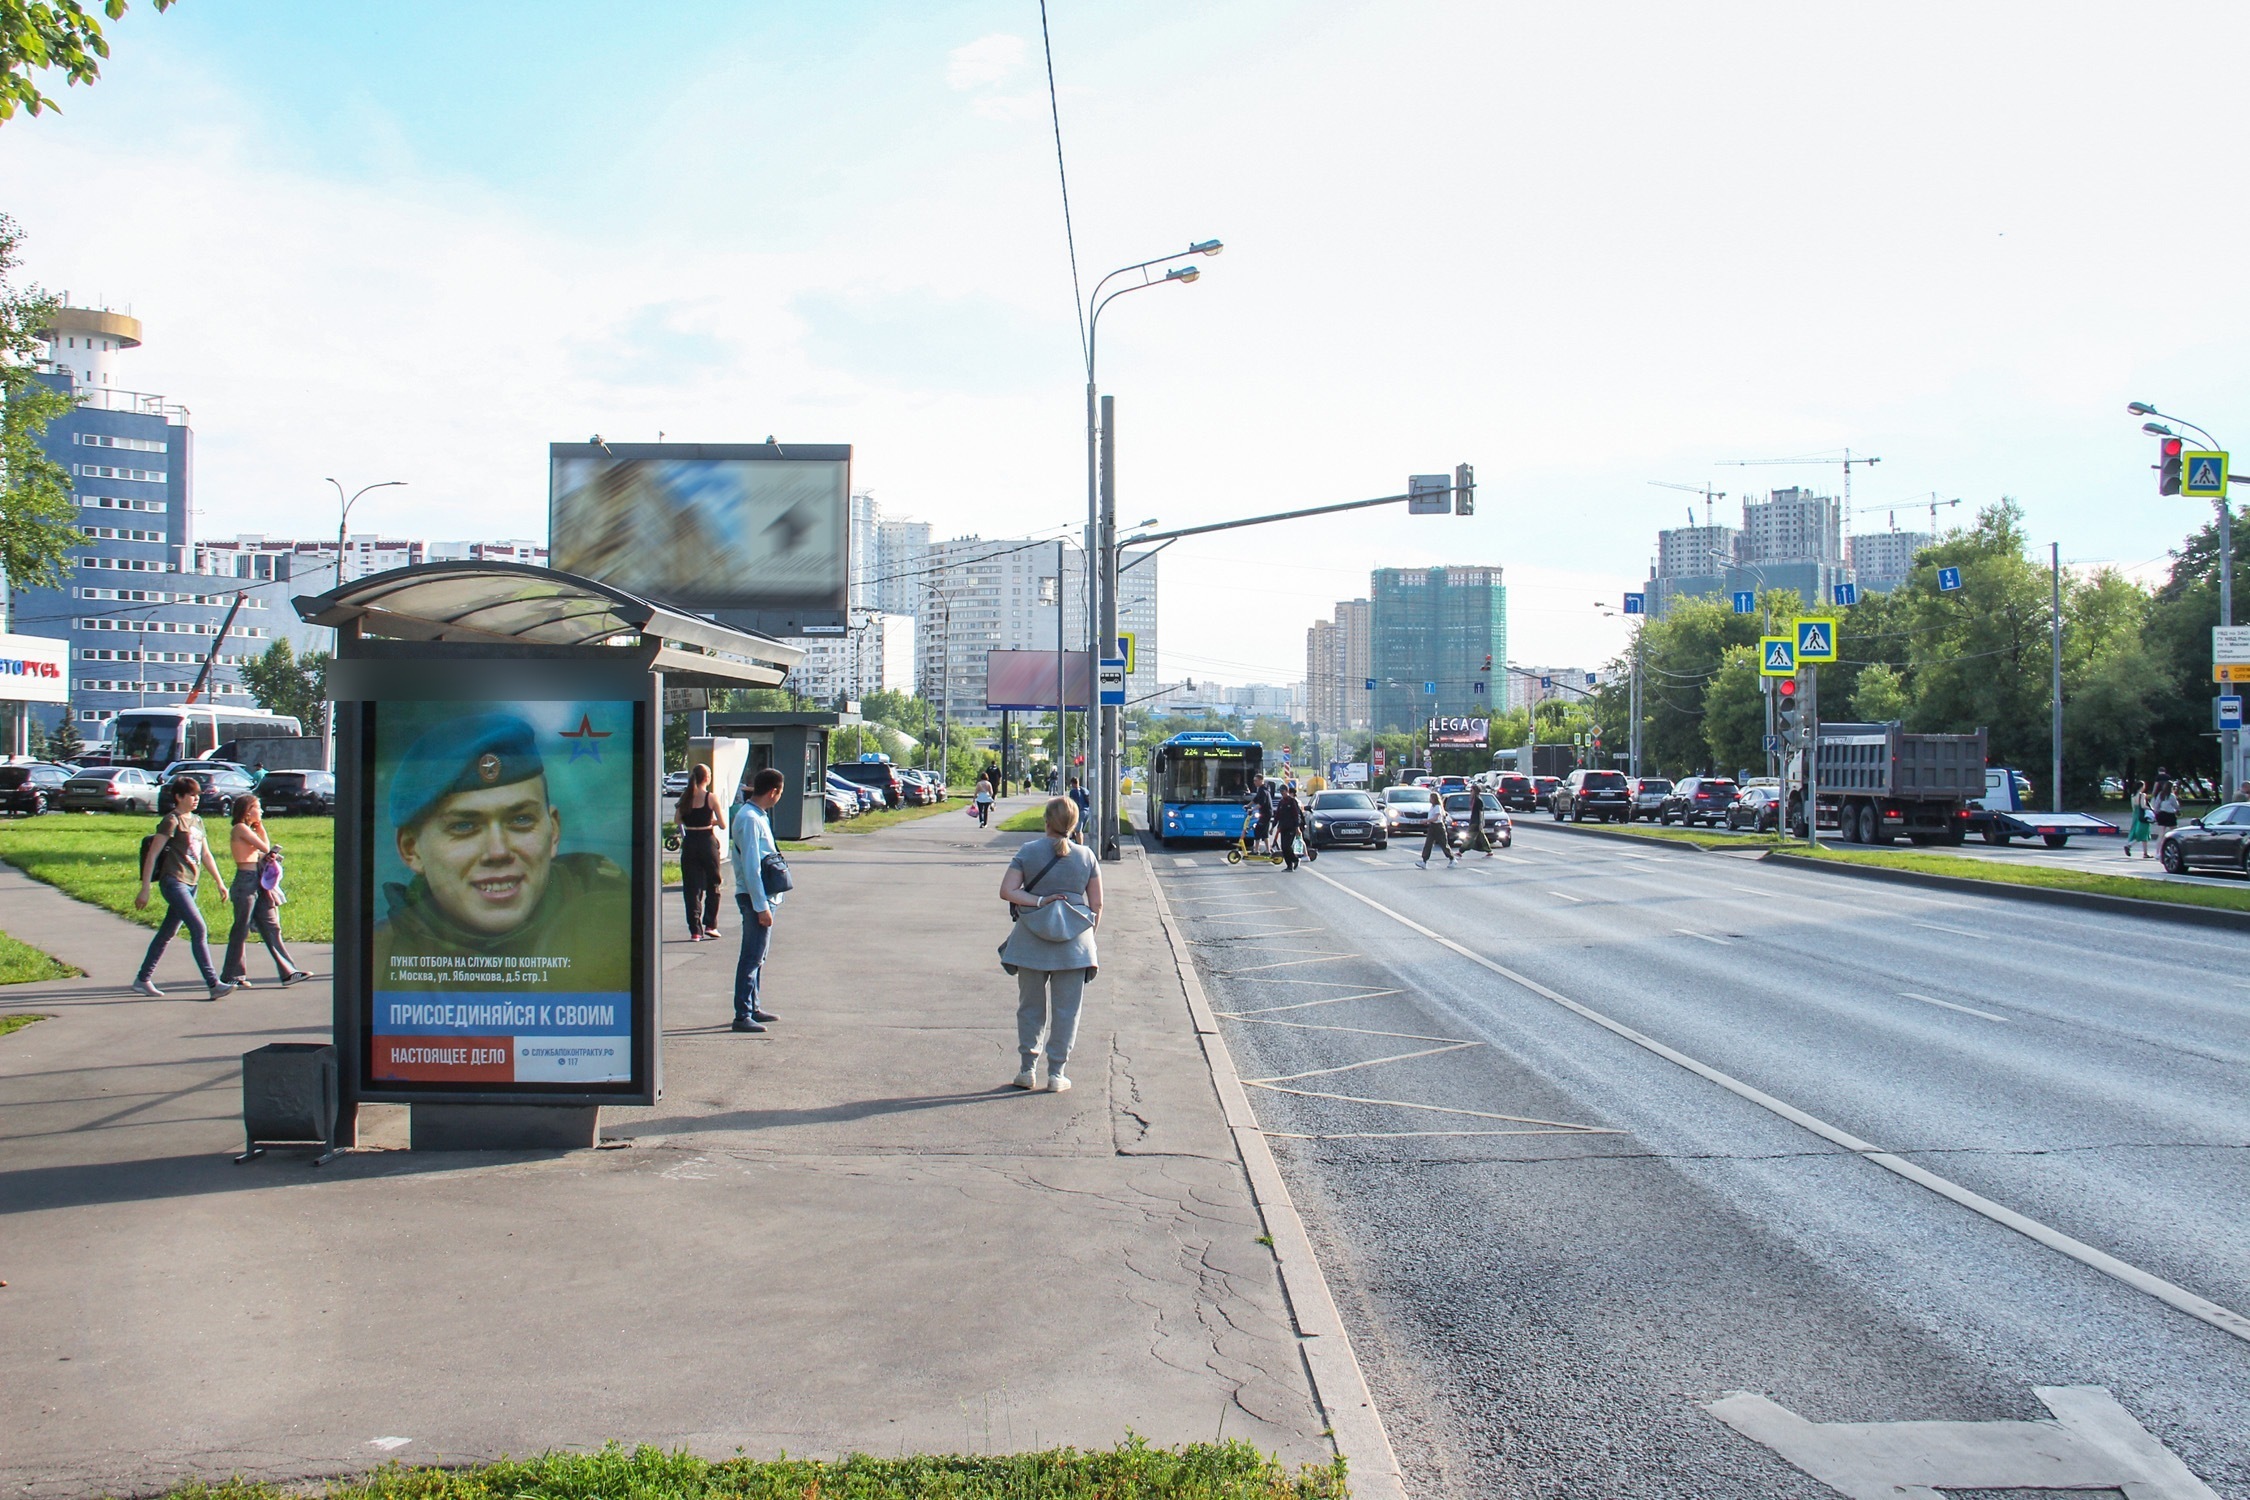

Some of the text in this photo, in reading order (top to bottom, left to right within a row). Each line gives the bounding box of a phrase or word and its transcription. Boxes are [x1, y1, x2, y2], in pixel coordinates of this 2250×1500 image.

[1432, 717, 1489, 738] LEGACY
[390, 956, 571, 968] ПУНКТ ОТБОРА НА СЛУЖБУ ПО КОНТРАКТУ:
[390, 970, 548, 983] г. Москва, ул. Яблочкова, д.5 стр. 1
[390, 1001, 614, 1027] ПРИСОЕДИНЯЙСЯ К СВОИМ
[391, 1048, 506, 1065] НАСТОЯЩЕЕ ДЕЛО
[531, 1048, 615, 1056] СЛУЖБАПОКОНТРАКТУ.РФ
[567, 1057, 578, 1066] 117
